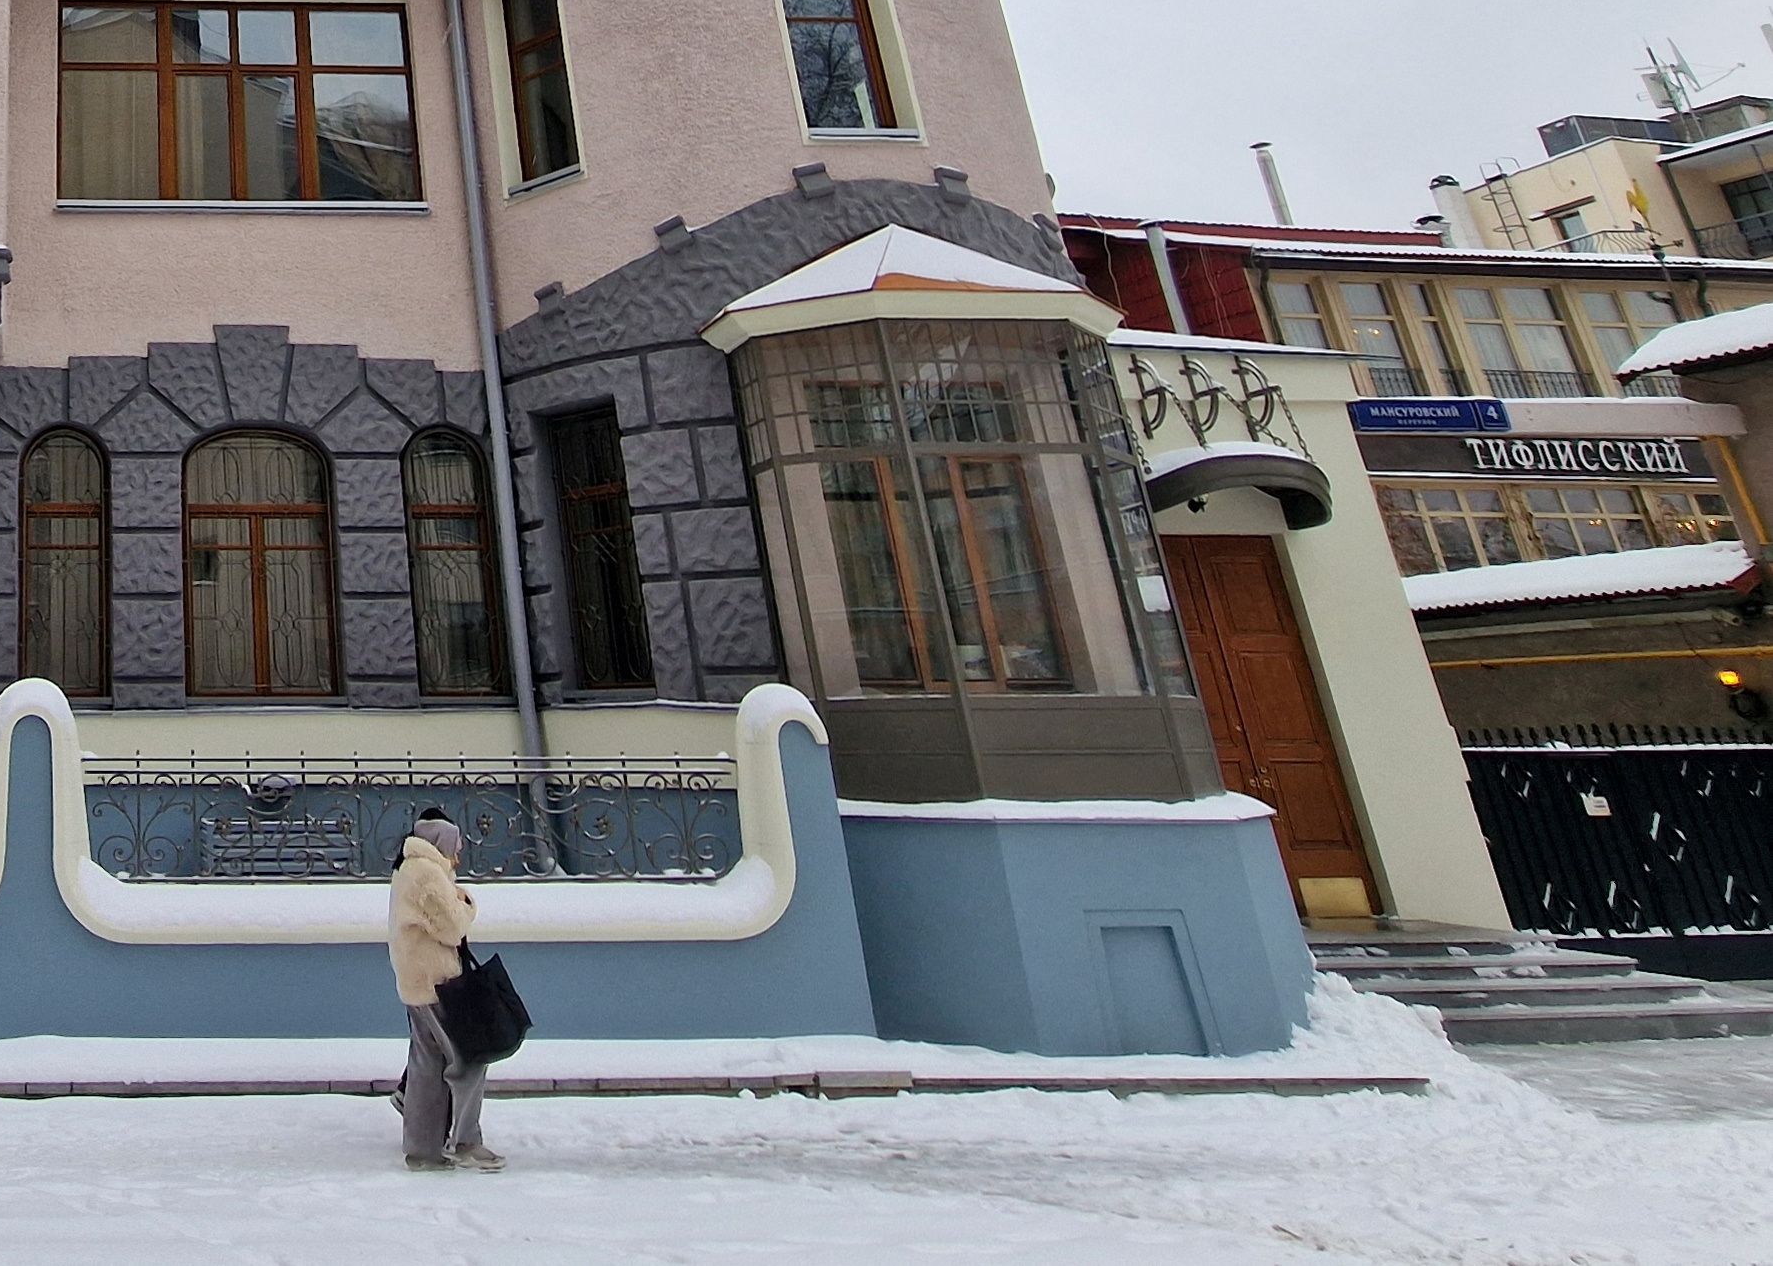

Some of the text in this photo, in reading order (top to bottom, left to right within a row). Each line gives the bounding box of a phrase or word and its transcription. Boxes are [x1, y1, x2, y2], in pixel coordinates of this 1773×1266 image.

[1369, 405, 1461, 418] МАНСУРОВСКИЙ
[1486, 405, 1499, 420] 4
[1464, 436, 1691, 474] ТИФЛИССКИЙ
